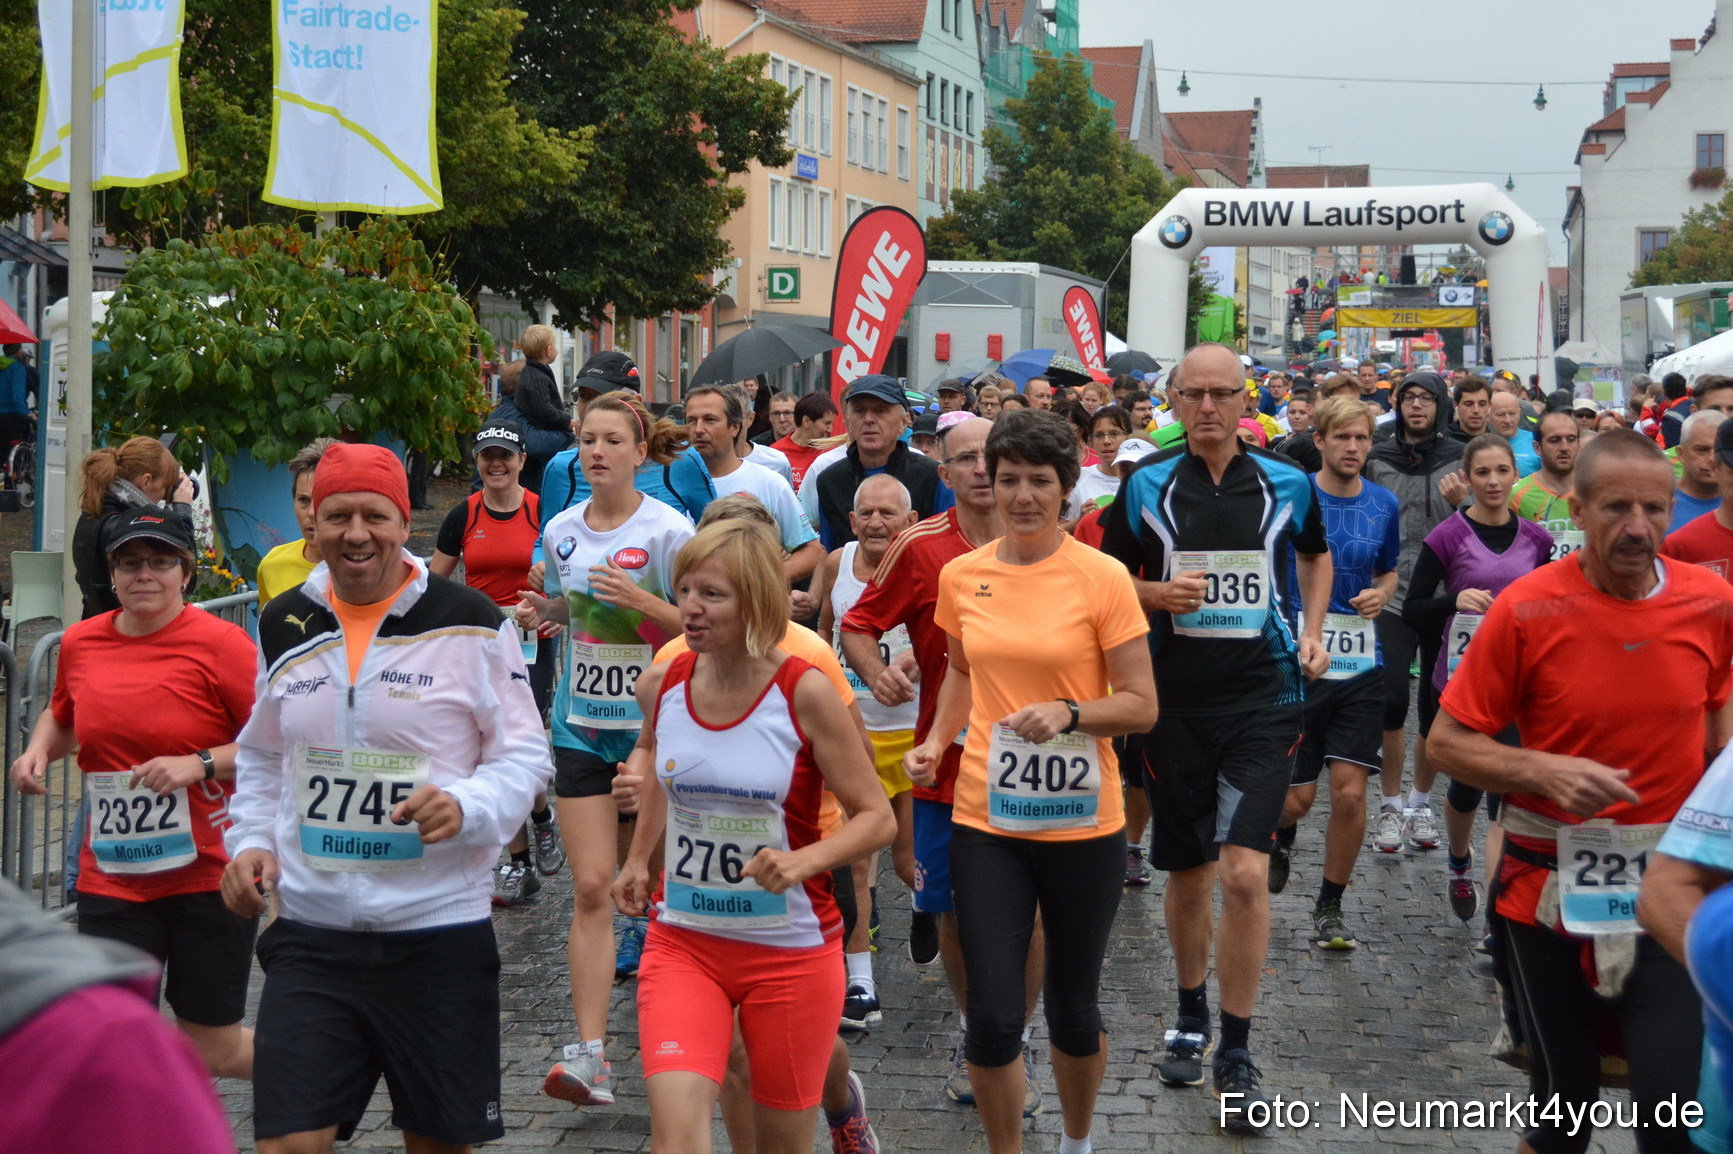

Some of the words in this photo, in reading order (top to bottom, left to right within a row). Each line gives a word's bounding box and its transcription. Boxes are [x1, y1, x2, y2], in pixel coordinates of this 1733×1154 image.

[282, 0, 420, 33] Fairtrade-
[288, 41, 364, 71] Stadt!
[1204, 200, 1294, 227] BMW
[1303, 199, 1466, 231] Laufsport
[772, 272, 795, 295] D
[837, 230, 912, 385] REWE
[1391, 312, 1423, 324] ZIEL
[476, 427, 519, 442] adidas
[1214, 554, 1260, 564] BOCK
[1203, 573, 1260, 604] 036
[1197, 613, 1243, 626] Johann
[1322, 629, 1365, 654] 761
[599, 647, 643, 658] BOCK
[380, 669, 414, 684] HÖHE
[418, 673, 434, 687] 111
[576, 662, 643, 696] 2203
[387, 686, 422, 701] Tennis
[586, 702, 626, 717] Carolin
[1047, 732, 1088, 747] OCK
[305, 757, 344, 767] NeuerMarkt
[351, 752, 416, 770] BOCK
[998, 751, 1090, 792] 2402
[307, 775, 414, 826] 2745
[675, 783, 750, 799] Physiotherapie
[751, 789, 777, 800] Wild
[98, 793, 180, 835] 2322
[1000, 798, 1084, 816] Heidemarie
[708, 815, 769, 832] BOCK
[1677, 806, 1732, 832] BOCK
[322, 834, 392, 859] Rüdiger
[1569, 835, 1612, 844] NeuerMarkt
[114, 843, 164, 860] Monika
[675, 834, 768, 884] 276
[691, 892, 753, 912] Claudia
